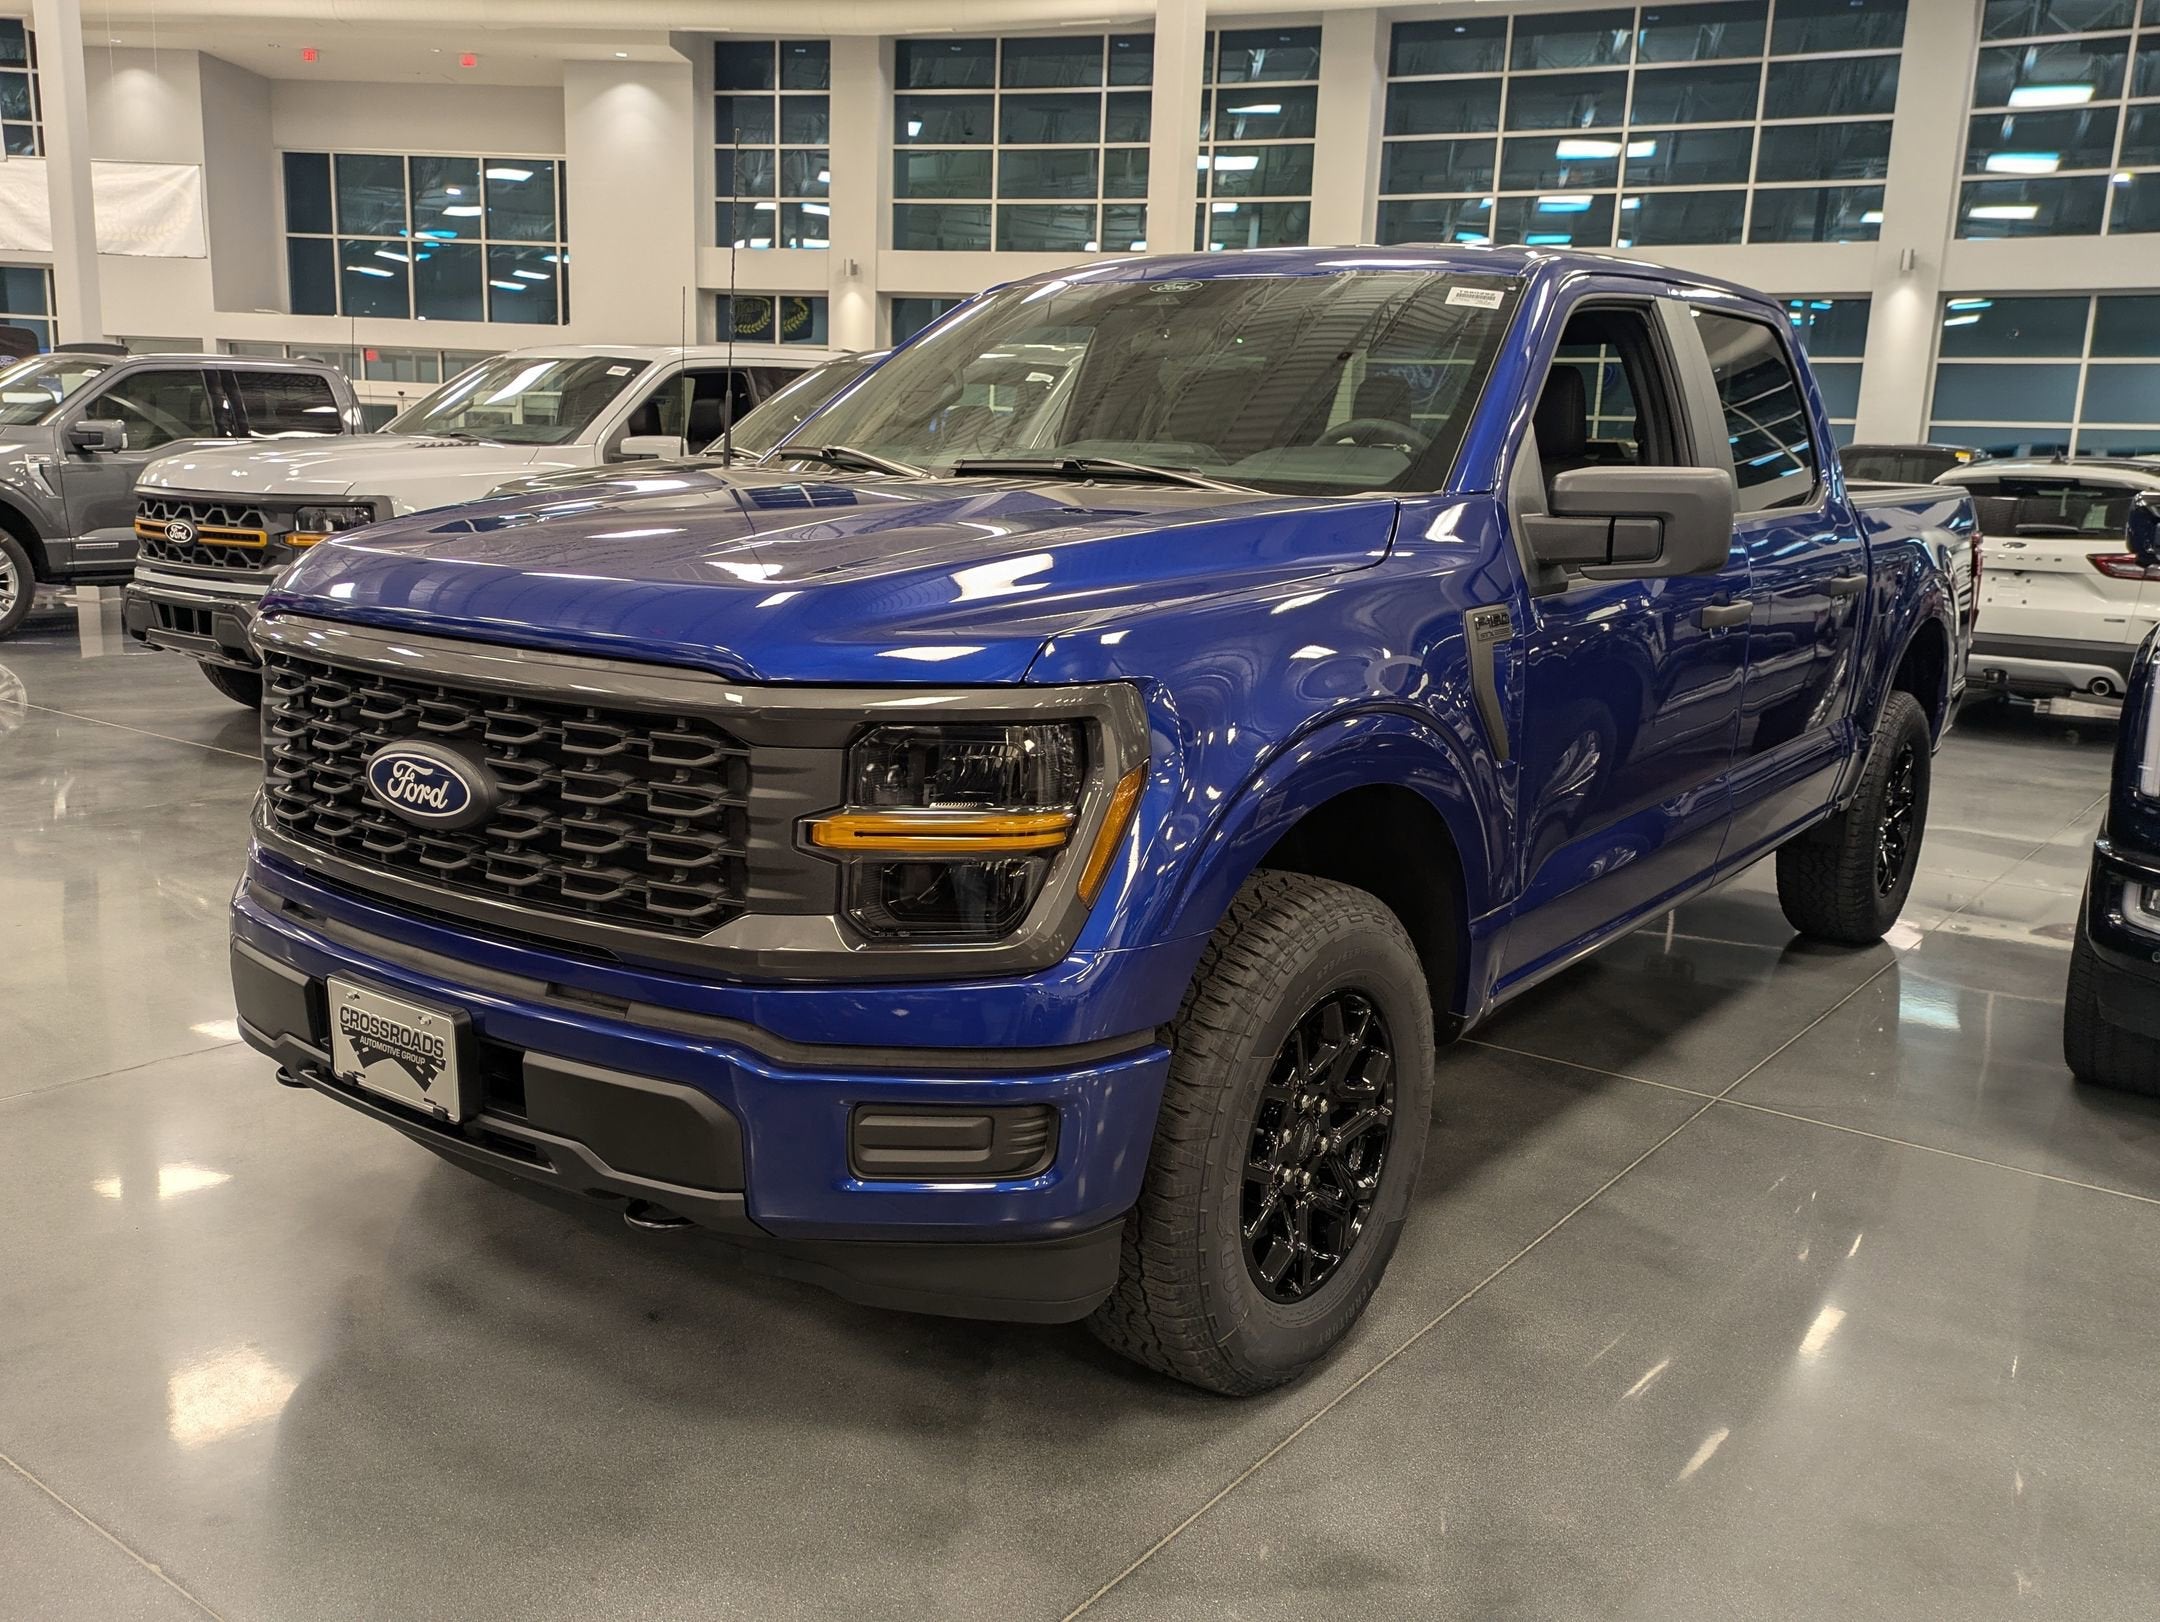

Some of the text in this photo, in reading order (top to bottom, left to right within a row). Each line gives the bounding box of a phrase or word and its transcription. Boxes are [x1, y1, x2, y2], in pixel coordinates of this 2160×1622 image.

[169, 524, 188, 540] Ford
[387, 760, 449, 810] Ford
[339, 1005, 445, 1059] CROSSROADS
[359, 1035, 426, 1066] AUTOMOTIVE GROUP
